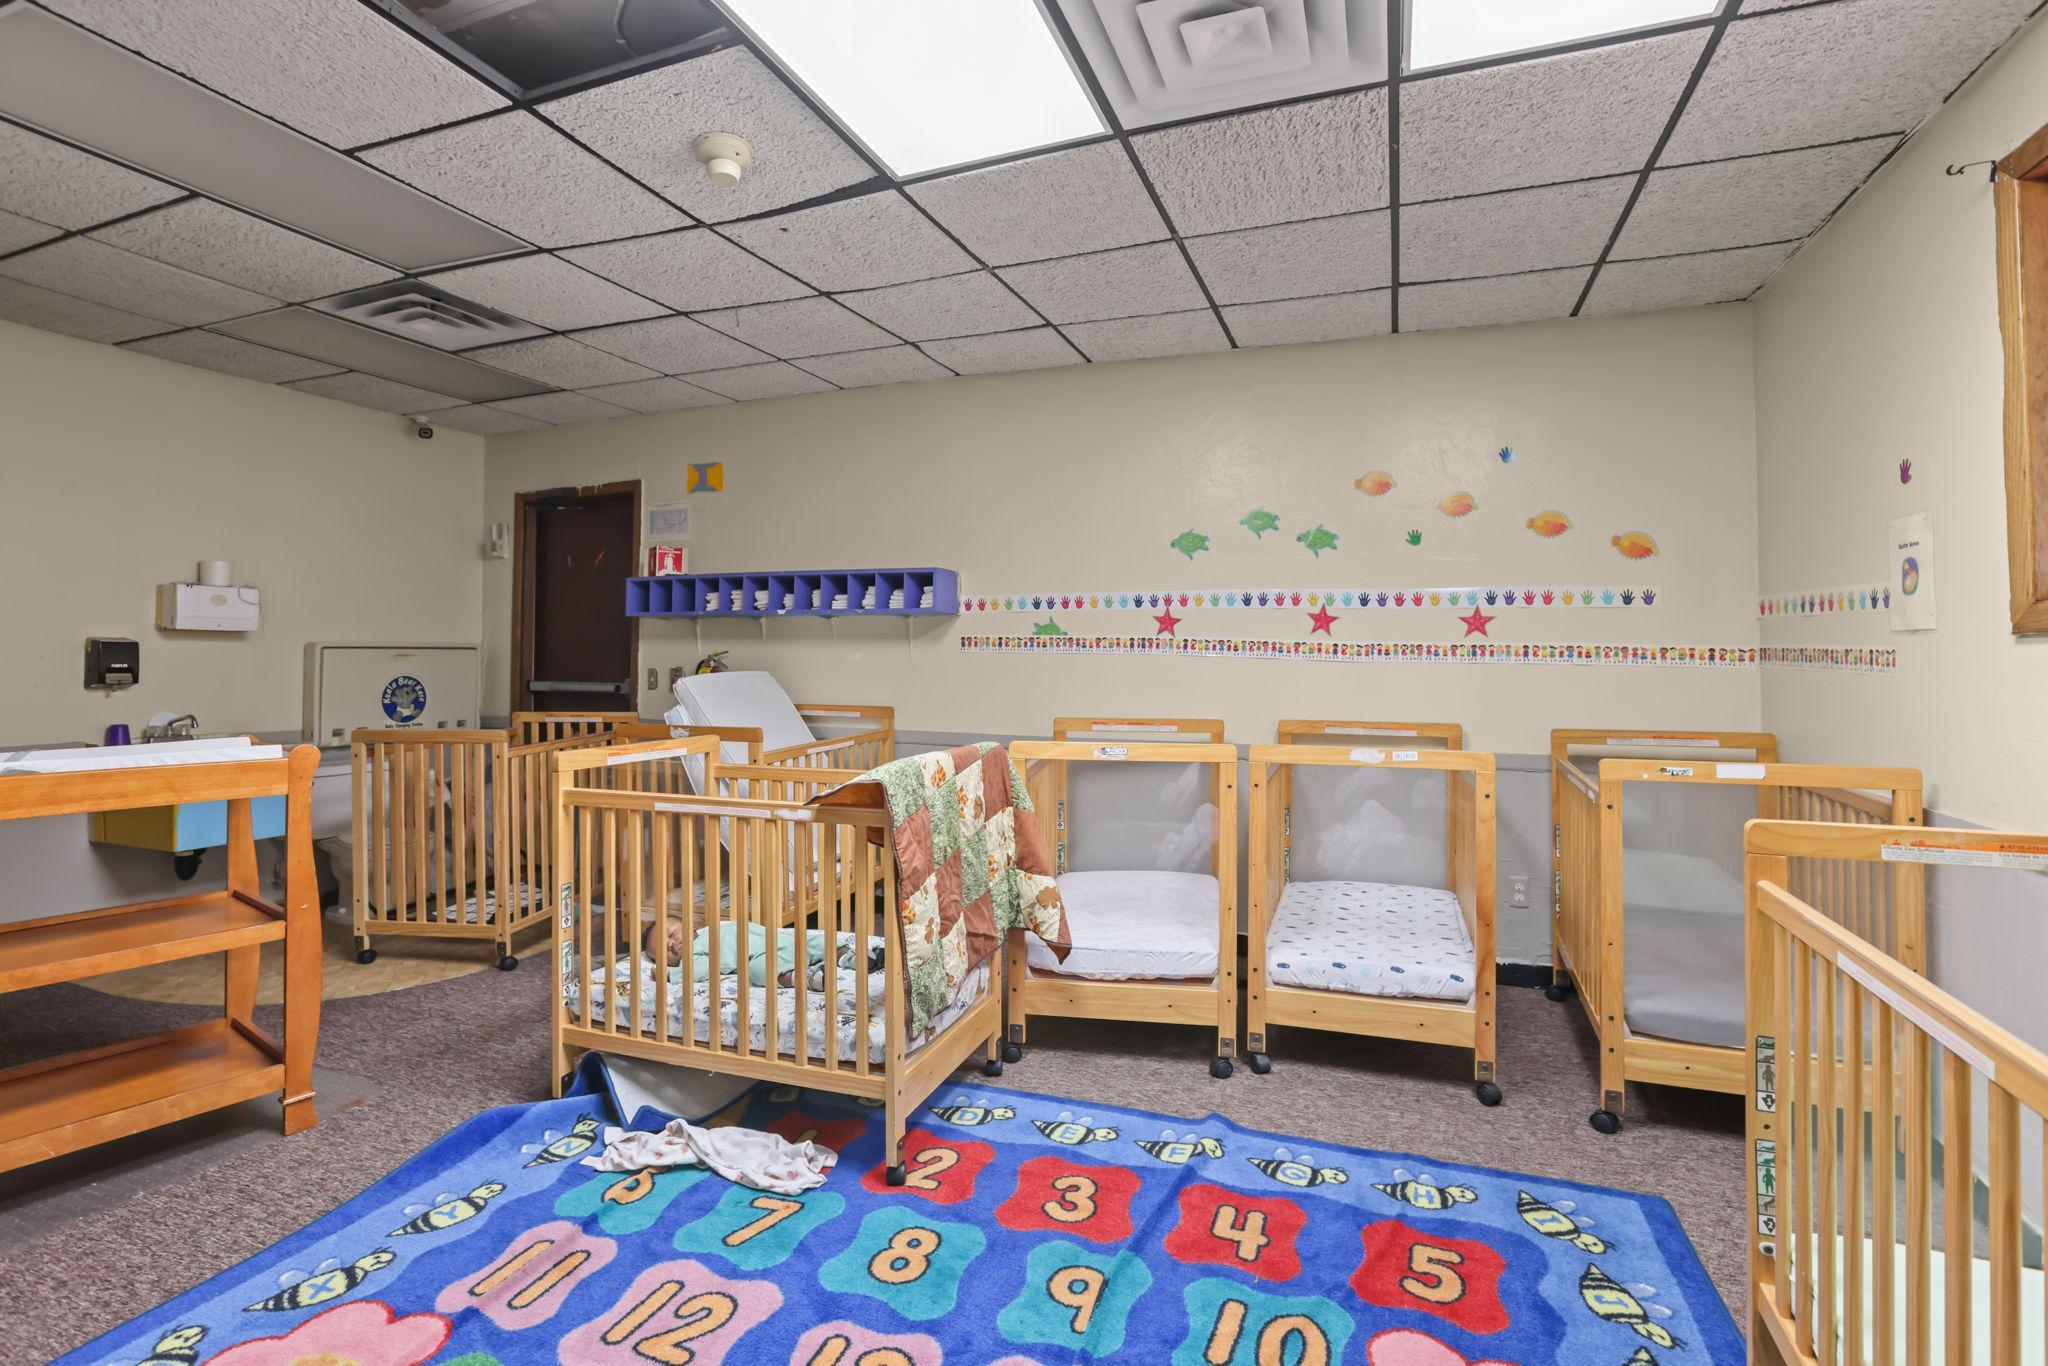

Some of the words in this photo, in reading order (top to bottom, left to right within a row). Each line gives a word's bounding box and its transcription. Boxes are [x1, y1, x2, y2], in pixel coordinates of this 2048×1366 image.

[383, 682, 397, 704] Koala
[398, 678, 417, 686] Bear
[414, 684, 425, 703] Kare
[957, 1109, 979, 1122] D
[1058, 1126, 1078, 1141] E
[904, 1146, 961, 1191] 2
[1167, 1146, 1187, 1159] F
[1280, 1166, 1308, 1182] G
[434, 1204, 458, 1219] Y
[1042, 1174, 1098, 1224] 3
[1413, 1187, 1435, 1205] H
[722, 1195, 805, 1247] 7
[1210, 1205, 1269, 1261] 4
[1531, 1214, 1562, 1226] I
[469, 1239, 591, 1310] 11
[869, 1226, 942, 1286] 8
[1401, 1242, 1465, 1304] 5
[307, 1274, 337, 1300] X
[1046, 1265, 1109, 1334] 9
[601, 1279, 739, 1366] 12
[1205, 1299, 1331, 1366] 10
